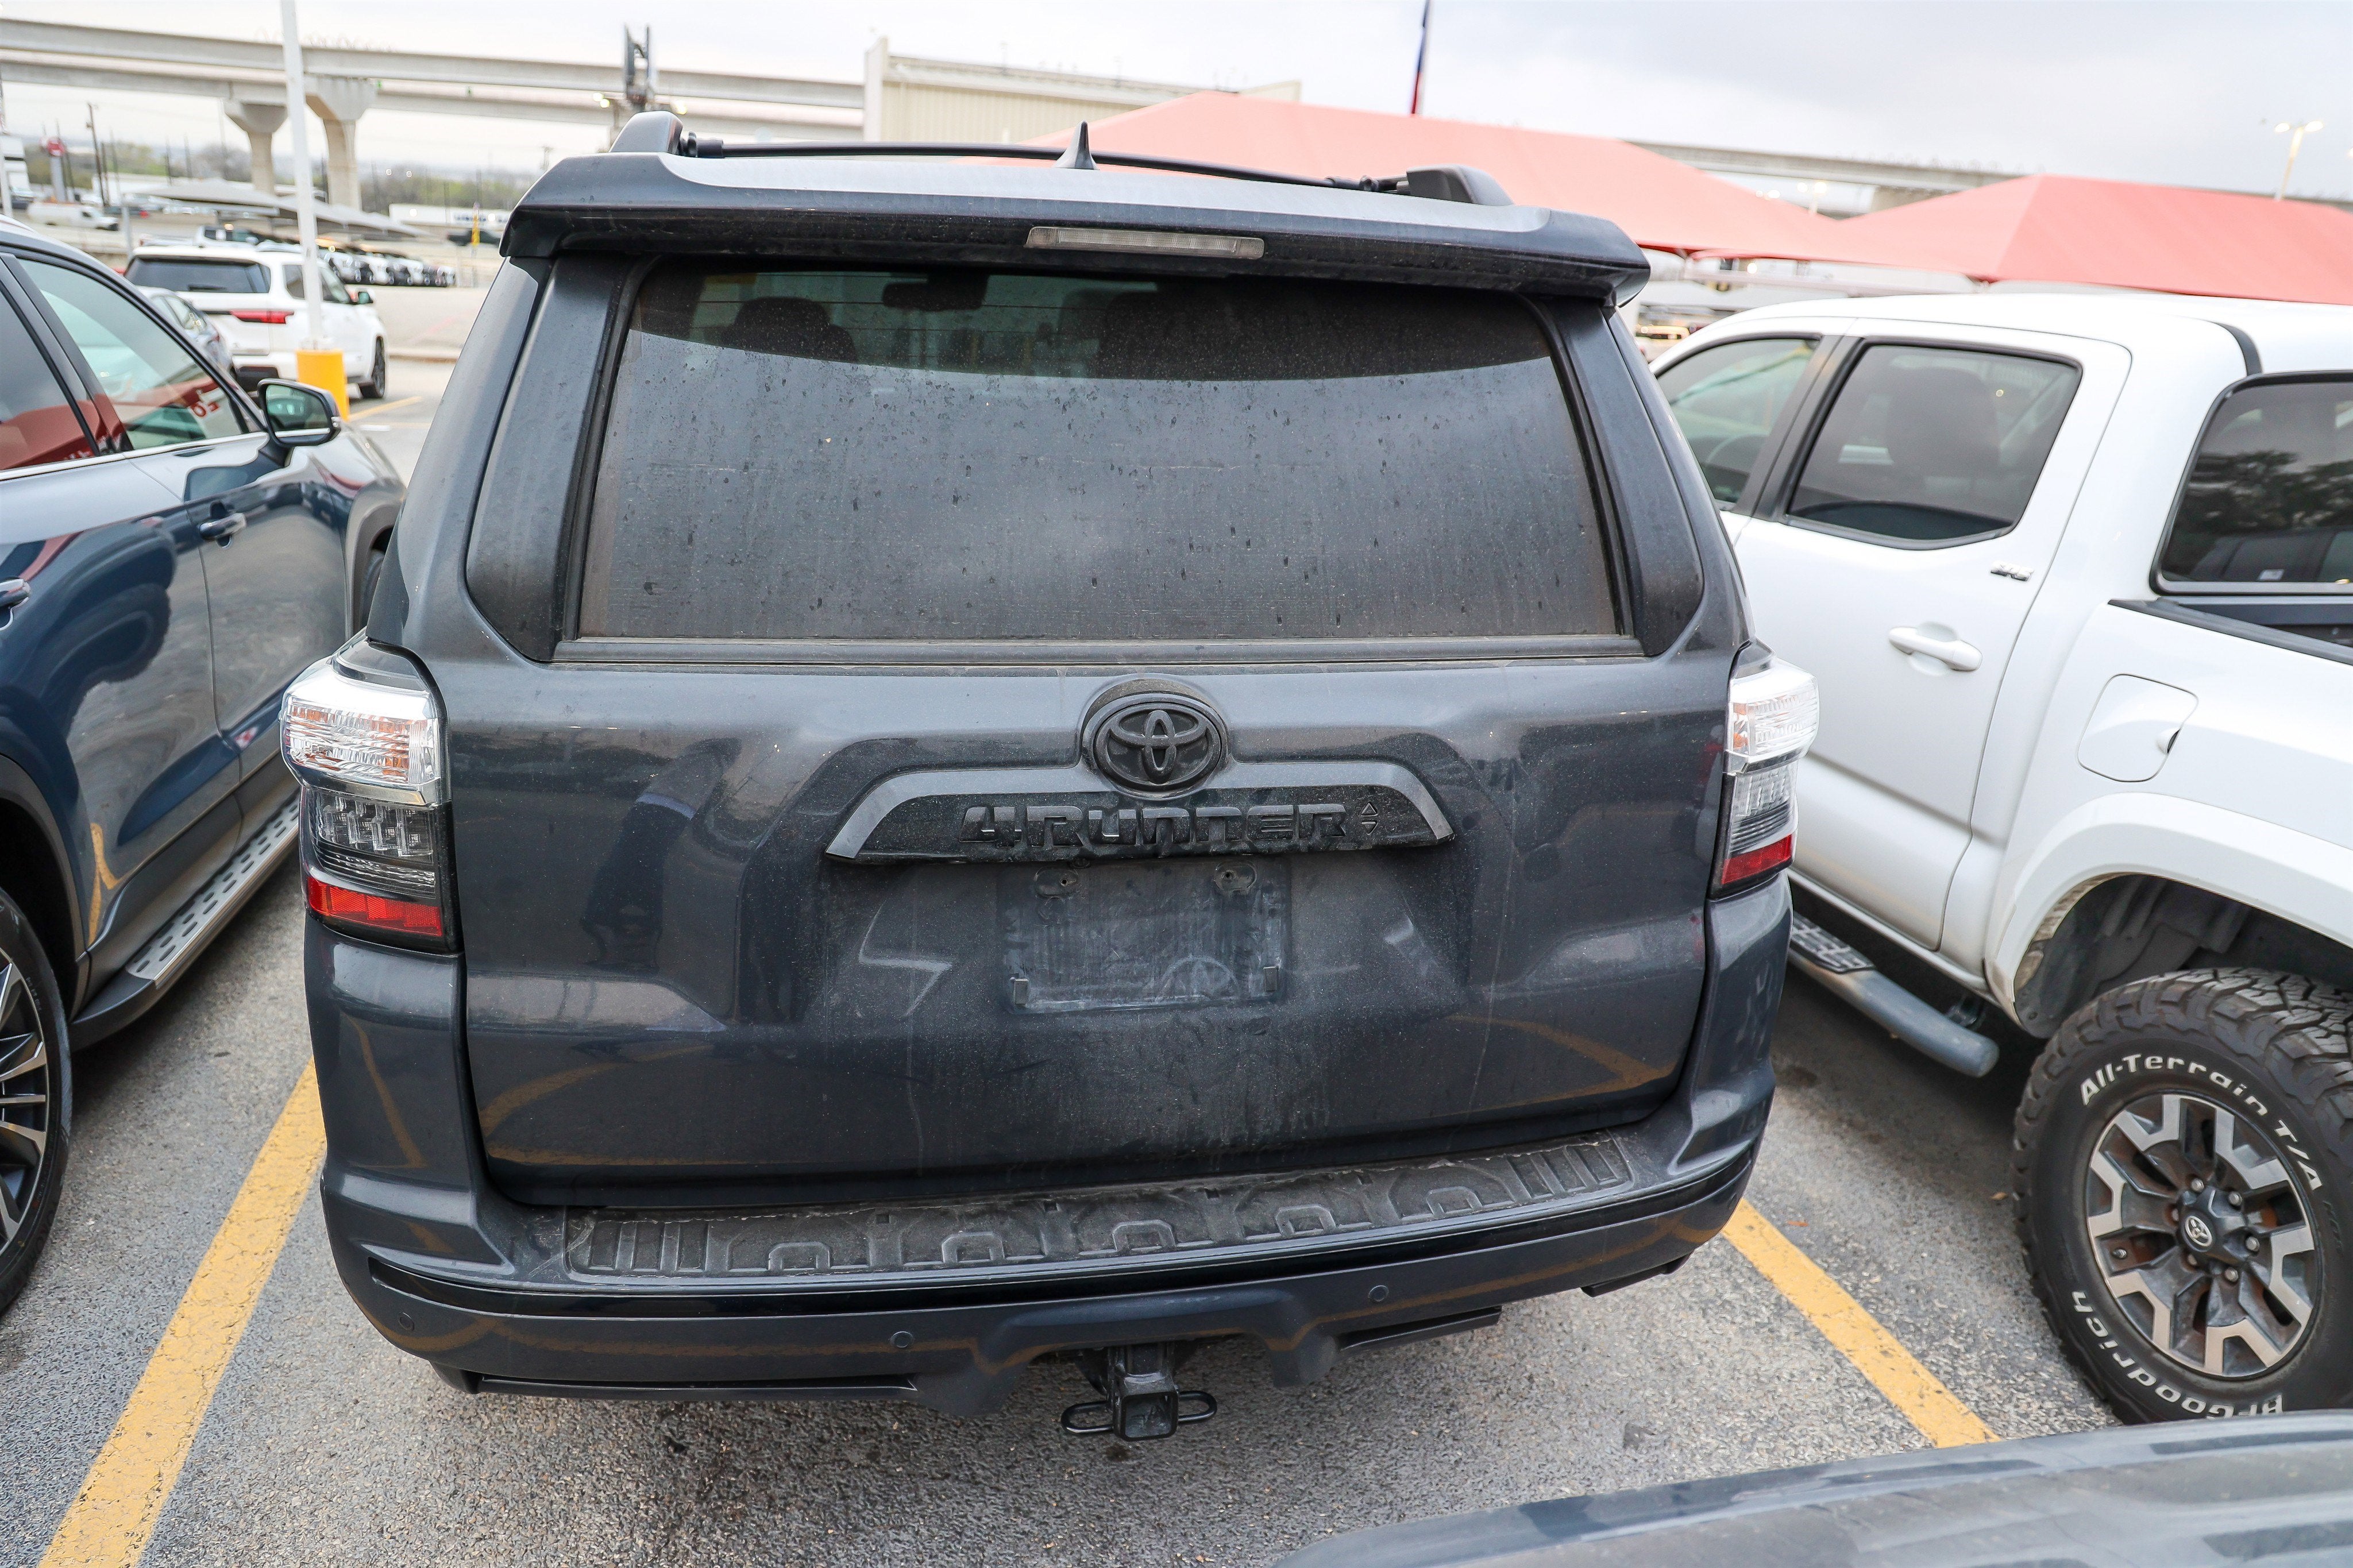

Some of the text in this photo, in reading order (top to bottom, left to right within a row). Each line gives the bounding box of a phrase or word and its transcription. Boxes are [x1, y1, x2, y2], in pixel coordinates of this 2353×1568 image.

[959, 804, 1347, 848] 4RUNNER
[2080, 1053, 2323, 1191] All-Terrain T/A
